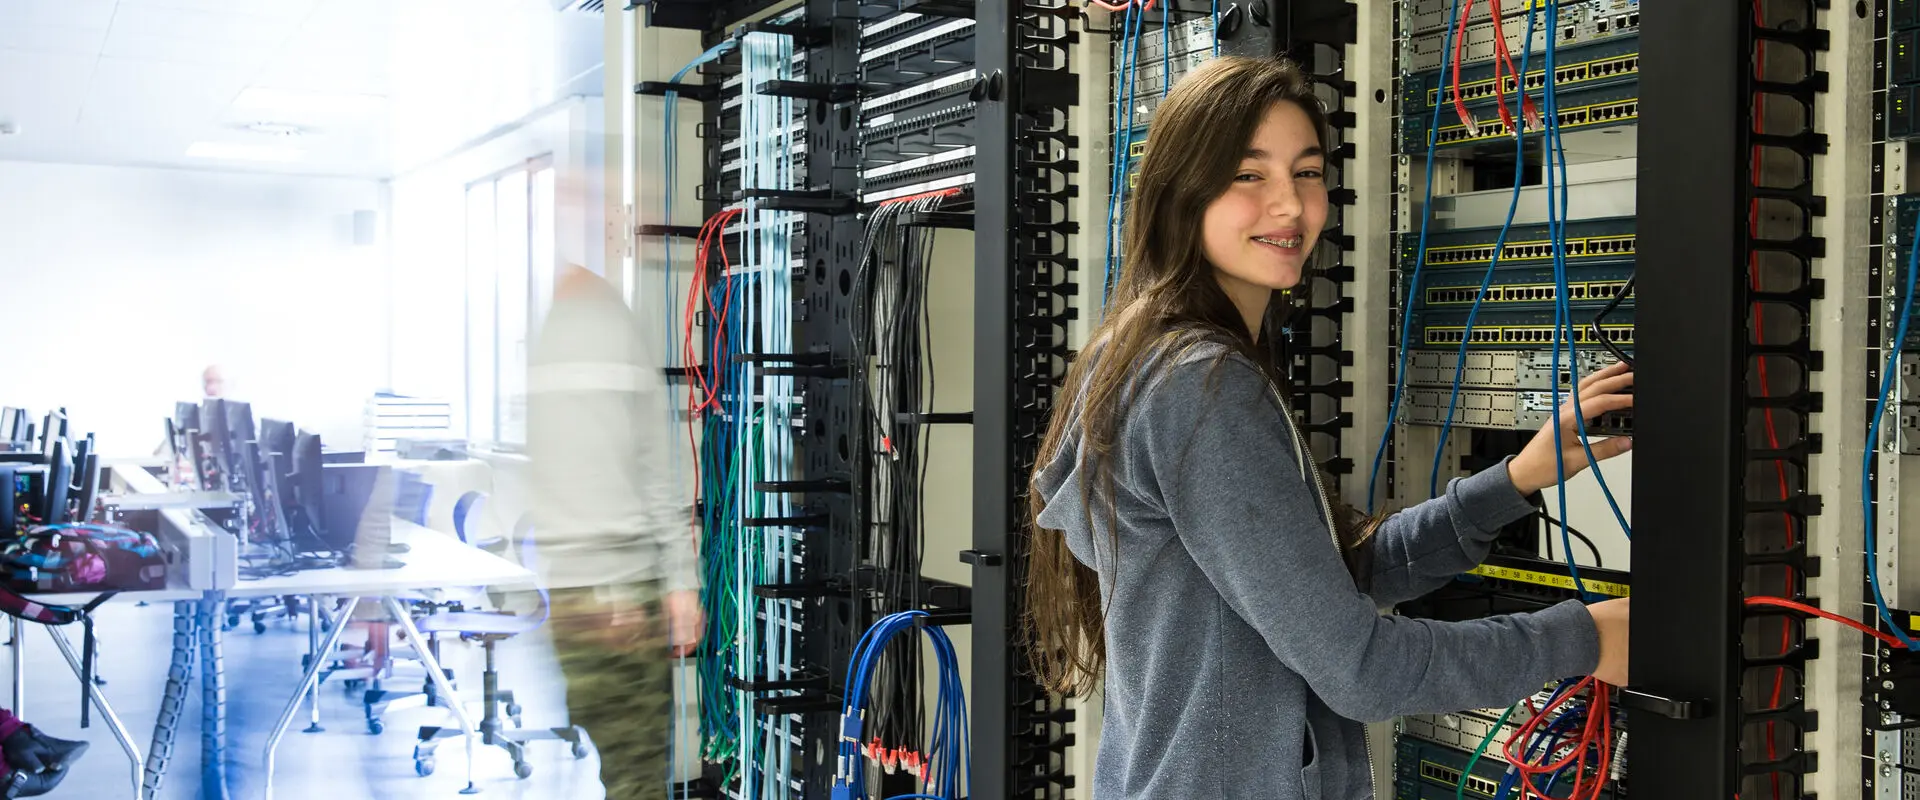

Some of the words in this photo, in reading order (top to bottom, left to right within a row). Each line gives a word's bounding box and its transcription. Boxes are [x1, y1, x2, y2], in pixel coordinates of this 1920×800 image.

[1877, 9, 1883, 17] 10
[1876, 61, 1883, 69] 11
[1875, 112, 1882, 121] 12
[1874, 164, 1881, 173] 13
[1872, 216, 1879, 224] 14
[1871, 267, 1878, 276] 15
[1870, 319, 1877, 327] 16
[1869, 370, 1876, 378] 17
[1538, 575, 1546, 583] 60
[1552, 577, 1559, 585] 61
[1865, 727, 1872, 736] 24
[1865, 778, 1872, 787] 25
